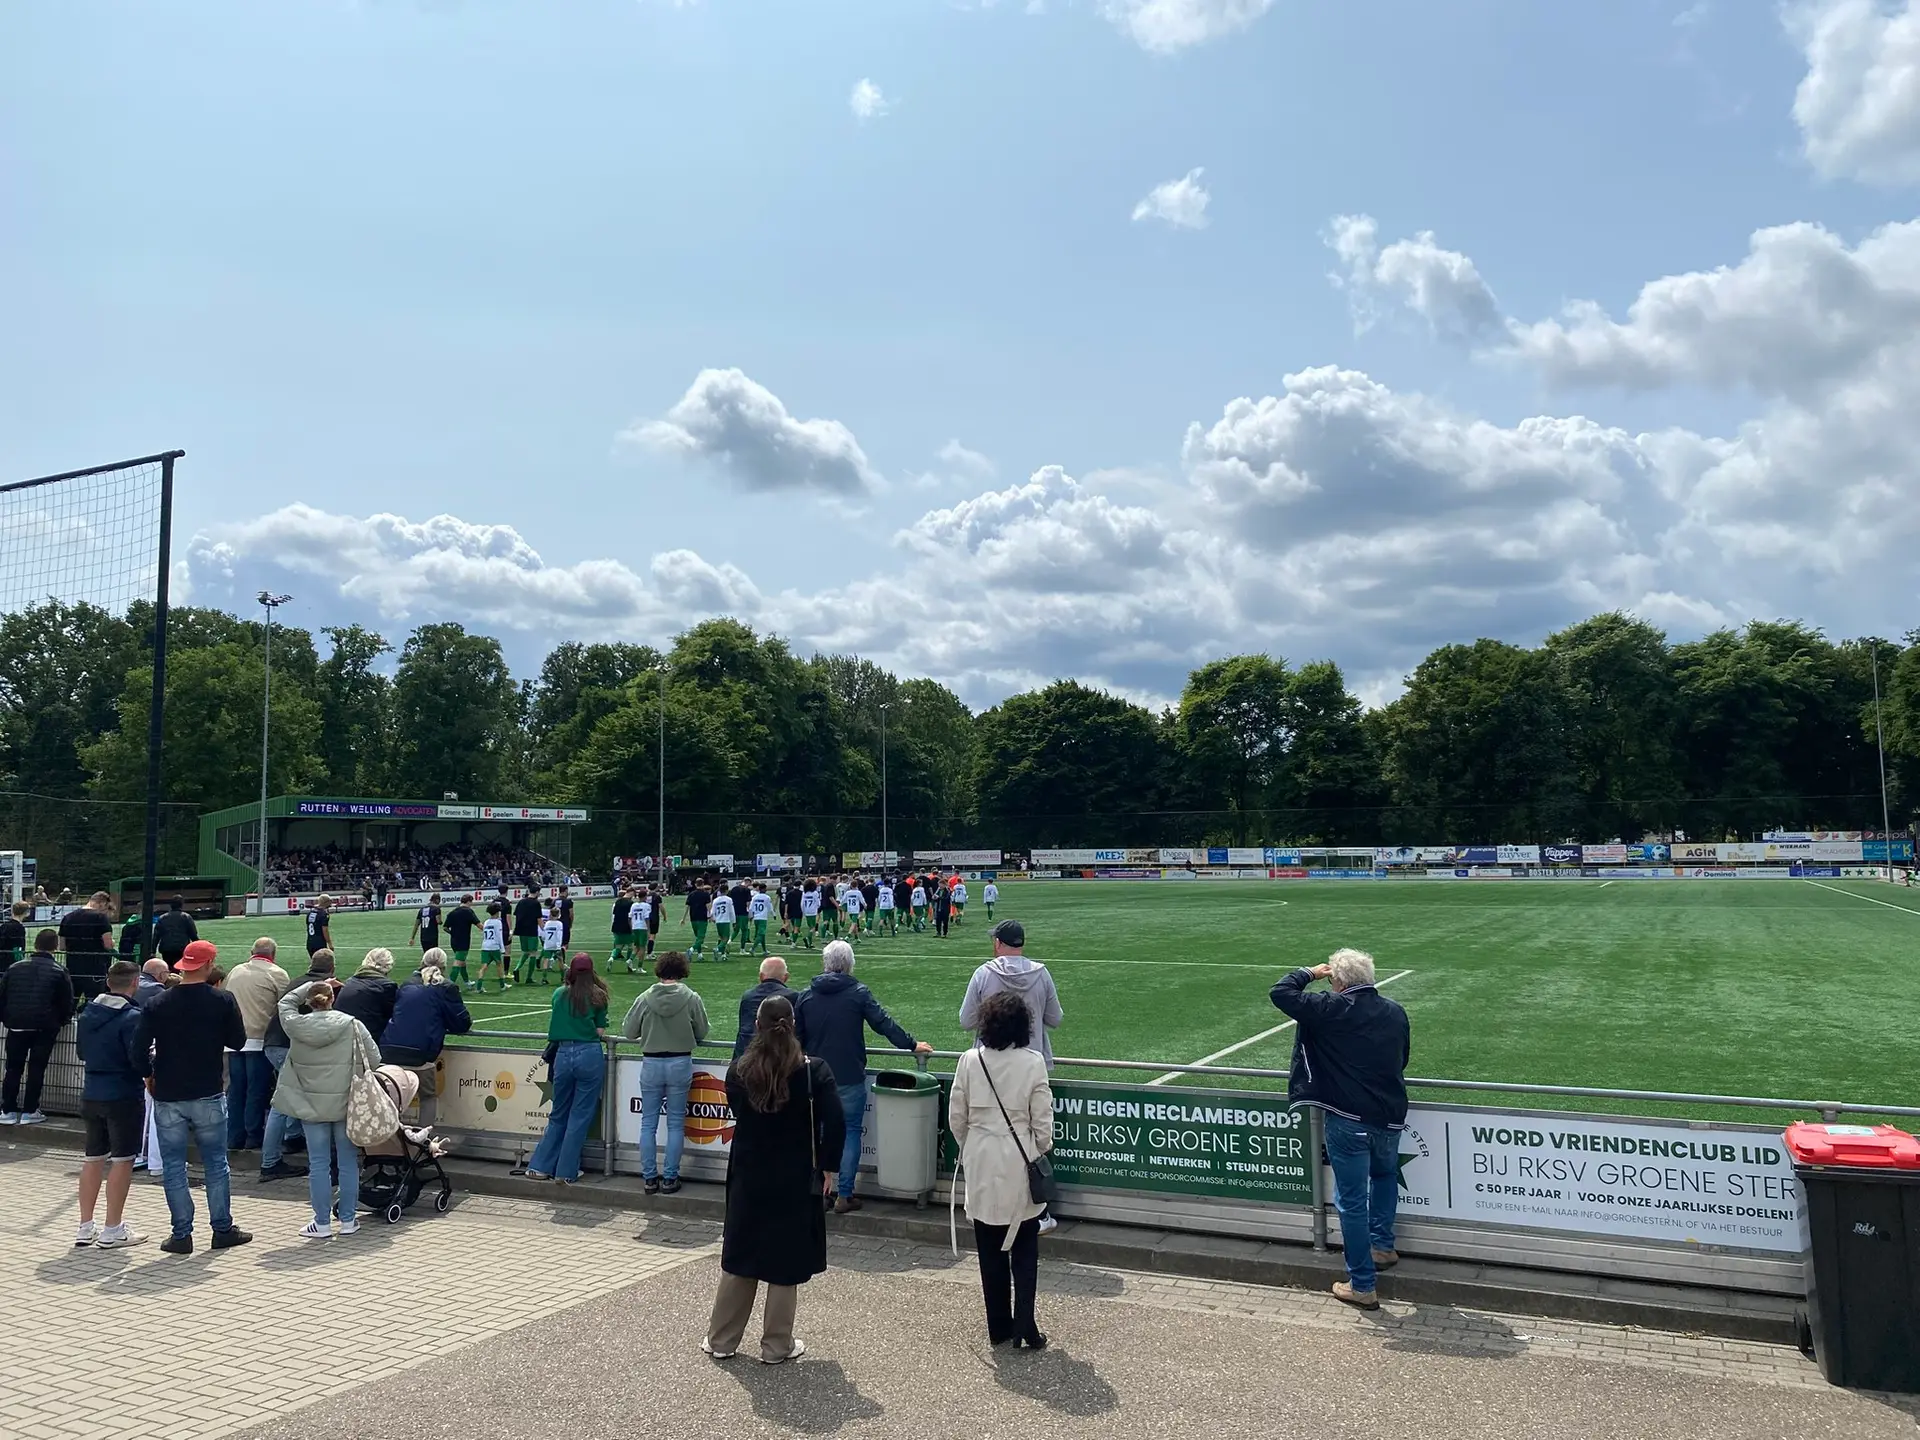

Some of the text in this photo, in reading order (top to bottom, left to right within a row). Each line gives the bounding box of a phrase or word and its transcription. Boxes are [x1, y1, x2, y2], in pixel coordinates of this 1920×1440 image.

[300, 803, 339, 812] RUTTEN
[350, 805, 391, 814] WELLING
[1096, 851, 1125, 860] MEEX
[397, 897, 422, 905] geelen
[754, 903, 764, 912] 10
[804, 900, 814, 908] 17
[848, 898, 857, 907] 18
[633, 913, 644, 922] 11
[308, 923, 315, 936] 8
[484, 930, 495, 940] 12
[547, 931, 555, 942] 7
[459, 1069, 511, 1097] partner van
[525, 1064, 538, 1084] RKSV
[692, 1103, 737, 1120] CONTA
[1053, 1098, 1302, 1129] UW EIGEN RECLAMEBORD?
[1053, 1121, 1303, 1159] BIJ RKSV GROENE STER
[1410, 1130, 1430, 1158] STER
[1472, 1126, 1780, 1166] WORD VRIENDENCLUB LID
[1053, 1148, 1304, 1176] GROTE EXPOSURE NETWERKEN STEUN DE CLUB
[1053, 1163, 1070, 1171] KOM
[1079, 1166, 1113, 1175] CONTACT
[1114, 1169, 1128, 1177] MET
[1130, 1170, 1148, 1178] ONZE
[1228, 1179, 1312, 1193] INFO@GROENESTER.NL
[1473, 1153, 1795, 1201] BIJ RKSV GROENE STER
[1475, 1183, 1793, 1220] € 50 PER JAAR VOOR ONZE JAARLIJKSE DOELEN!
[1475, 1200, 1782, 1237] STUUR EEN E-MAIL NAAR INFO@GROENESTER.NL OF VIA HET BESTUUR
